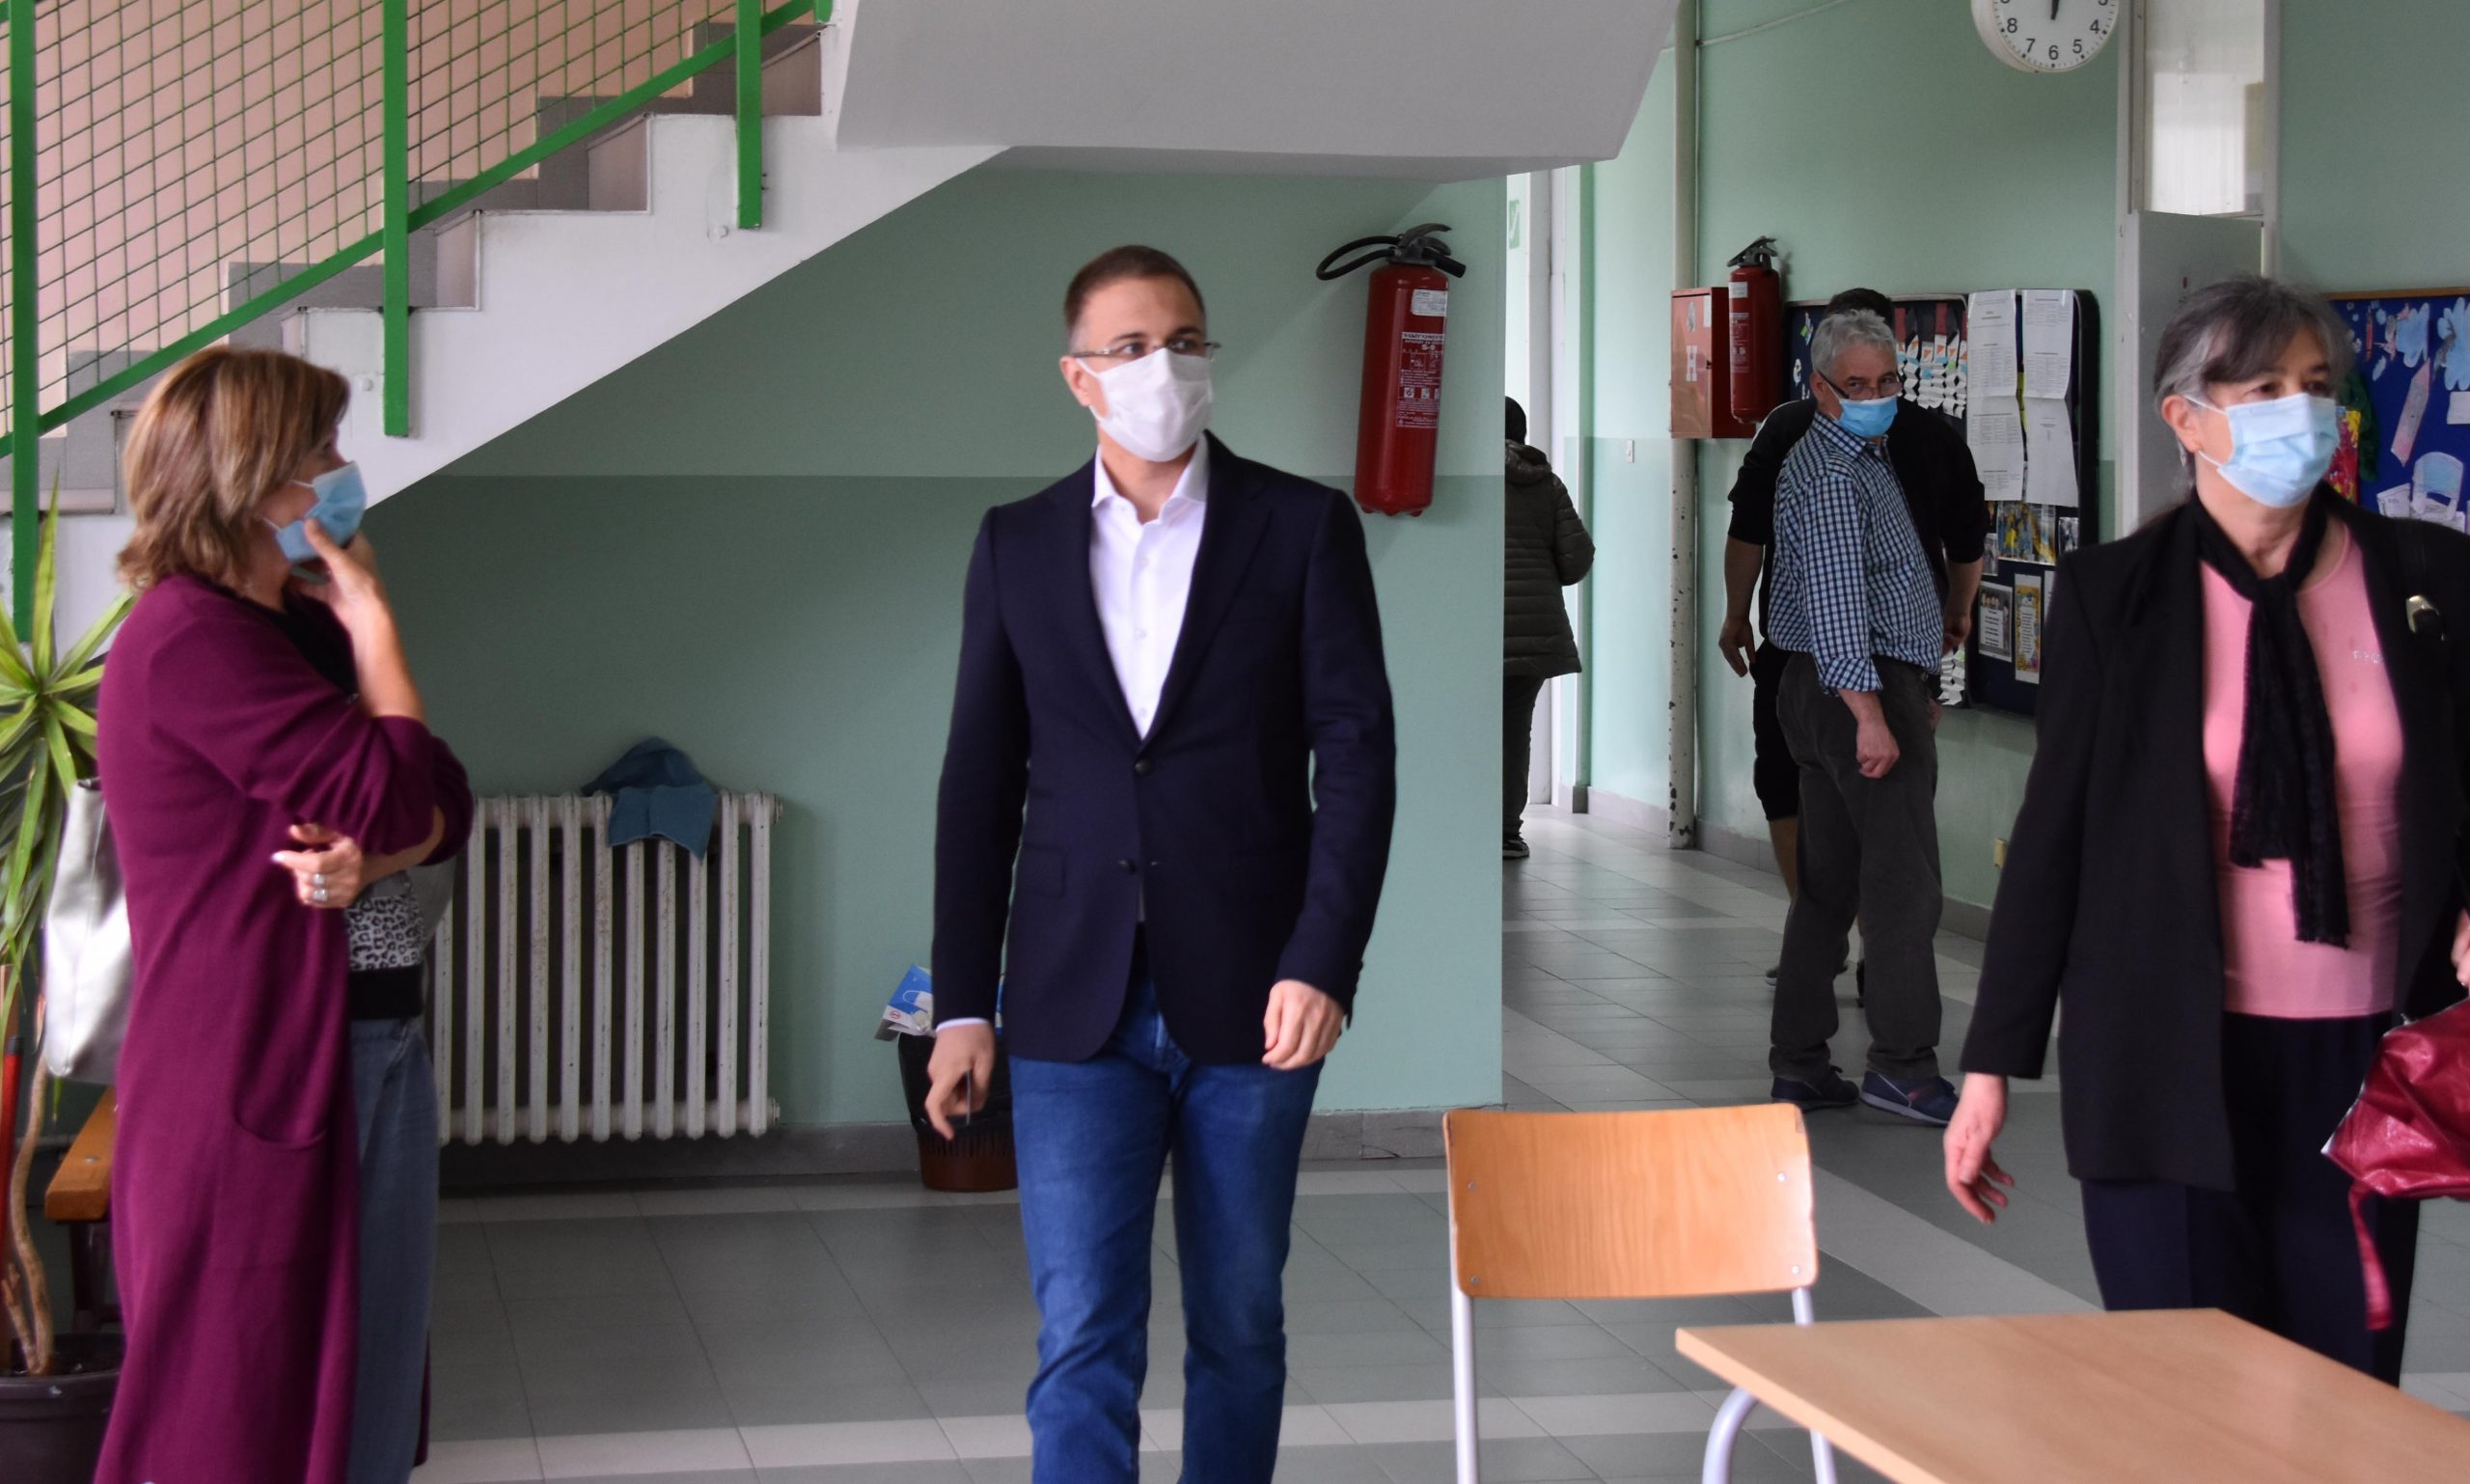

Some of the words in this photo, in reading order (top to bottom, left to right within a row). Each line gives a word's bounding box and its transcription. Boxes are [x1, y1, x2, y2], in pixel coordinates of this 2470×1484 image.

[2006, 17, 2017, 34] 8
[2090, 19, 2100, 34] 4
[2026, 39, 2036, 53] 7
[2048, 45, 2059, 60] 6
[2072, 39, 2083, 54] 5
[1686, 345, 1697, 382] H
